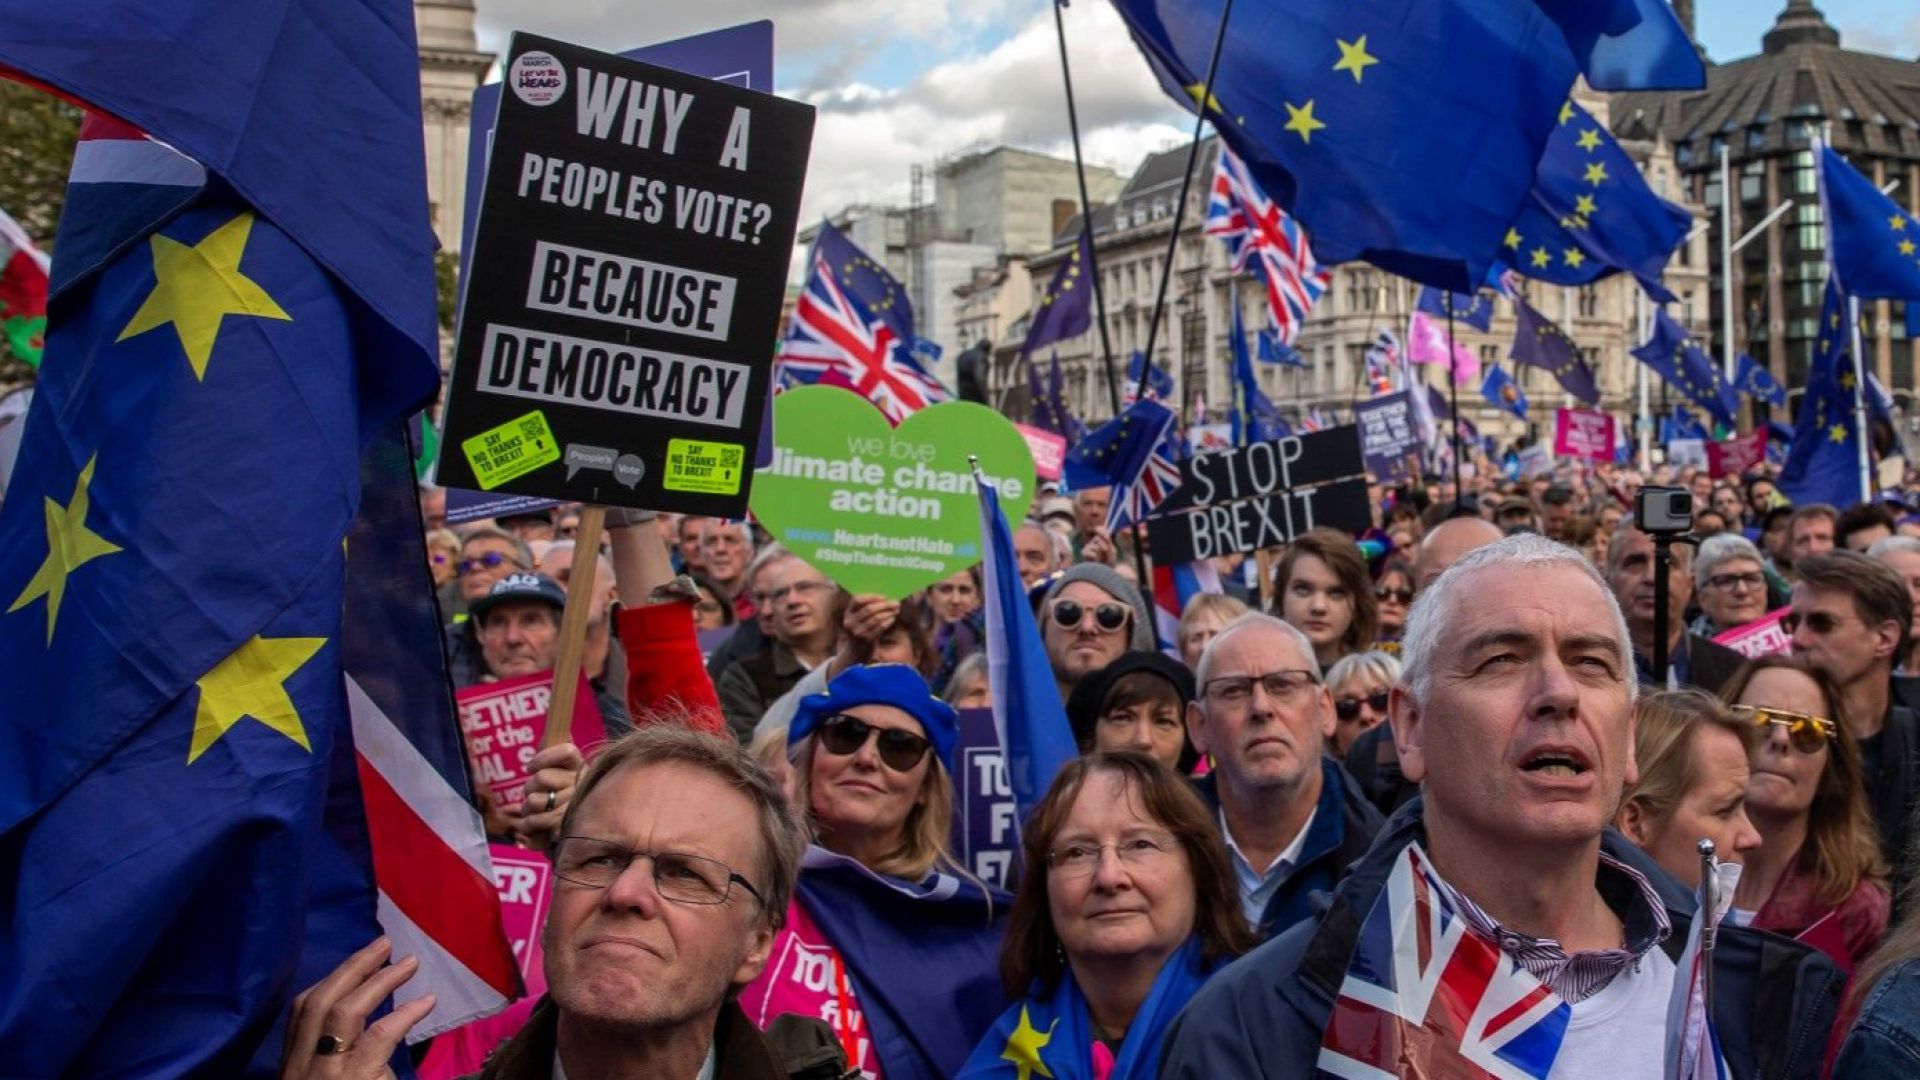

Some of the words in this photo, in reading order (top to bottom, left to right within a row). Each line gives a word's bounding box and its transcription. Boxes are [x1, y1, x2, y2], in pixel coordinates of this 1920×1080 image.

[576, 66, 694, 155] WHY
[719, 106, 751, 171] A
[518, 152, 667, 225] PEOPLES
[675, 184, 772, 246] VOTE?
[539, 249, 722, 333] BECAUSE
[488, 332, 740, 420] DEMOCRACY
[485, 432, 501, 446] SAY
[487, 436, 523, 457] THANKS
[688, 444, 703, 455] SAY
[848, 436, 884, 457] we
[889, 435, 936, 462] love
[493, 448, 524, 467] BREXIT
[618, 464, 641, 475] Vote
[671, 454, 684, 465] NO
[685, 455, 717, 467] THANKS
[673, 465, 683, 475] TO
[684, 466, 713, 477] BREXIT
[771, 447, 886, 486] limate
[1189, 435, 1304, 507] STOP
[830, 487, 941, 521] action
[1189, 488, 1317, 560] BREXIT
[496, 724, 534, 747] the
[492, 865, 537, 904] ER
